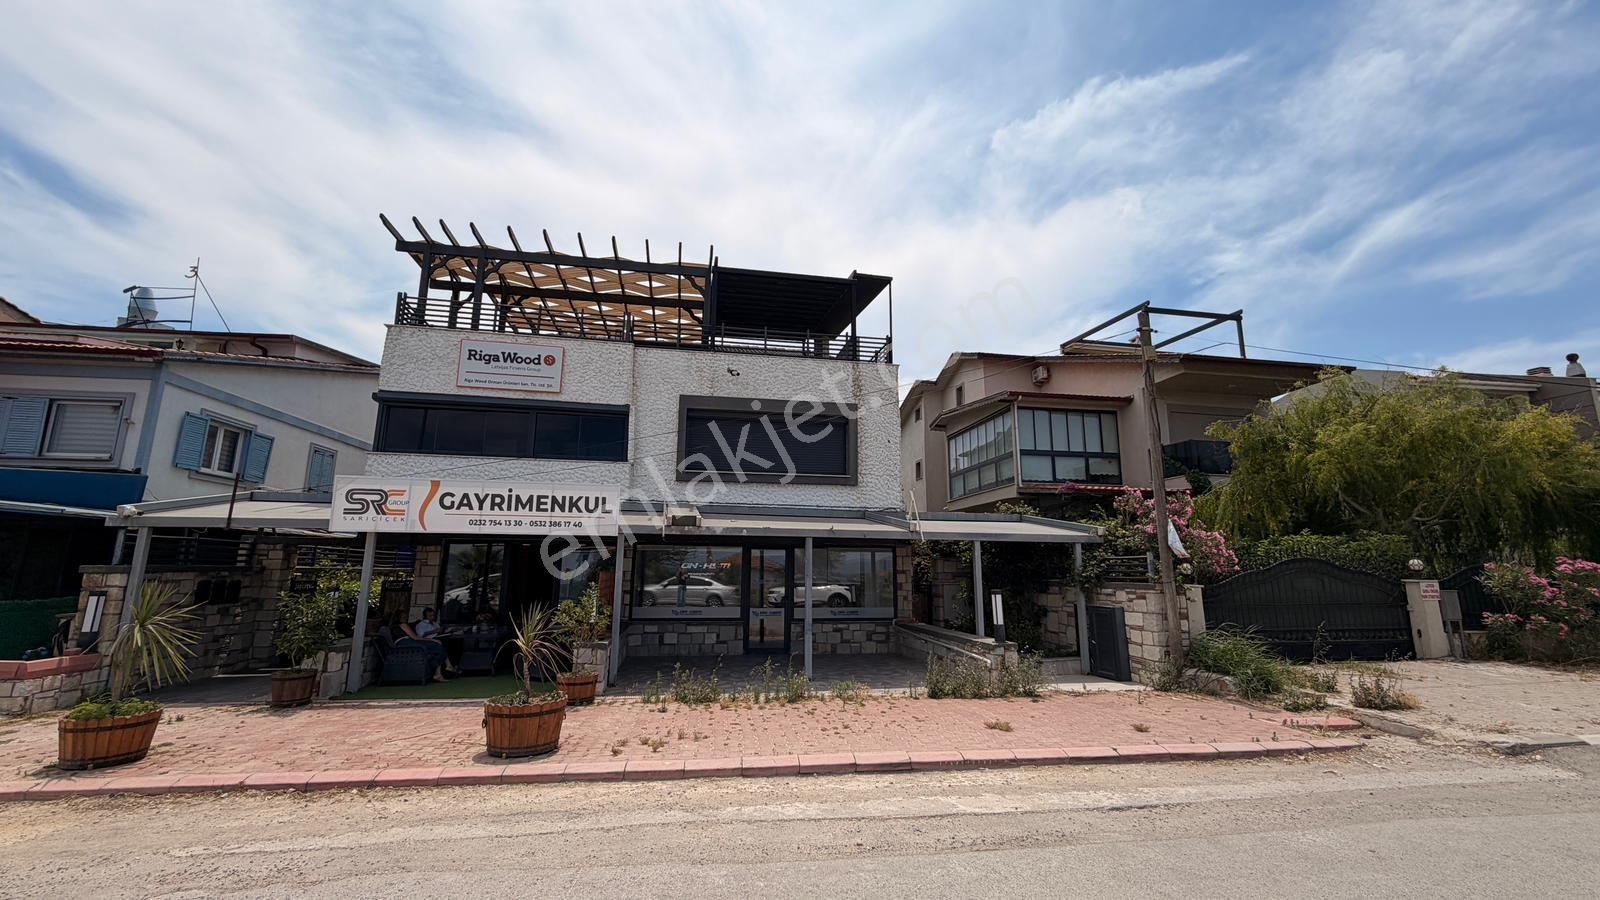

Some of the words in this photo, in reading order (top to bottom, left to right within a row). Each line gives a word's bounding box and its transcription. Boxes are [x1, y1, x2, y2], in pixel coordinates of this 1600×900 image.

[467, 349, 500, 364] Riga
[501, 351, 541, 365] Wood
[438, 488, 613, 514] GAYRİMENKUL
